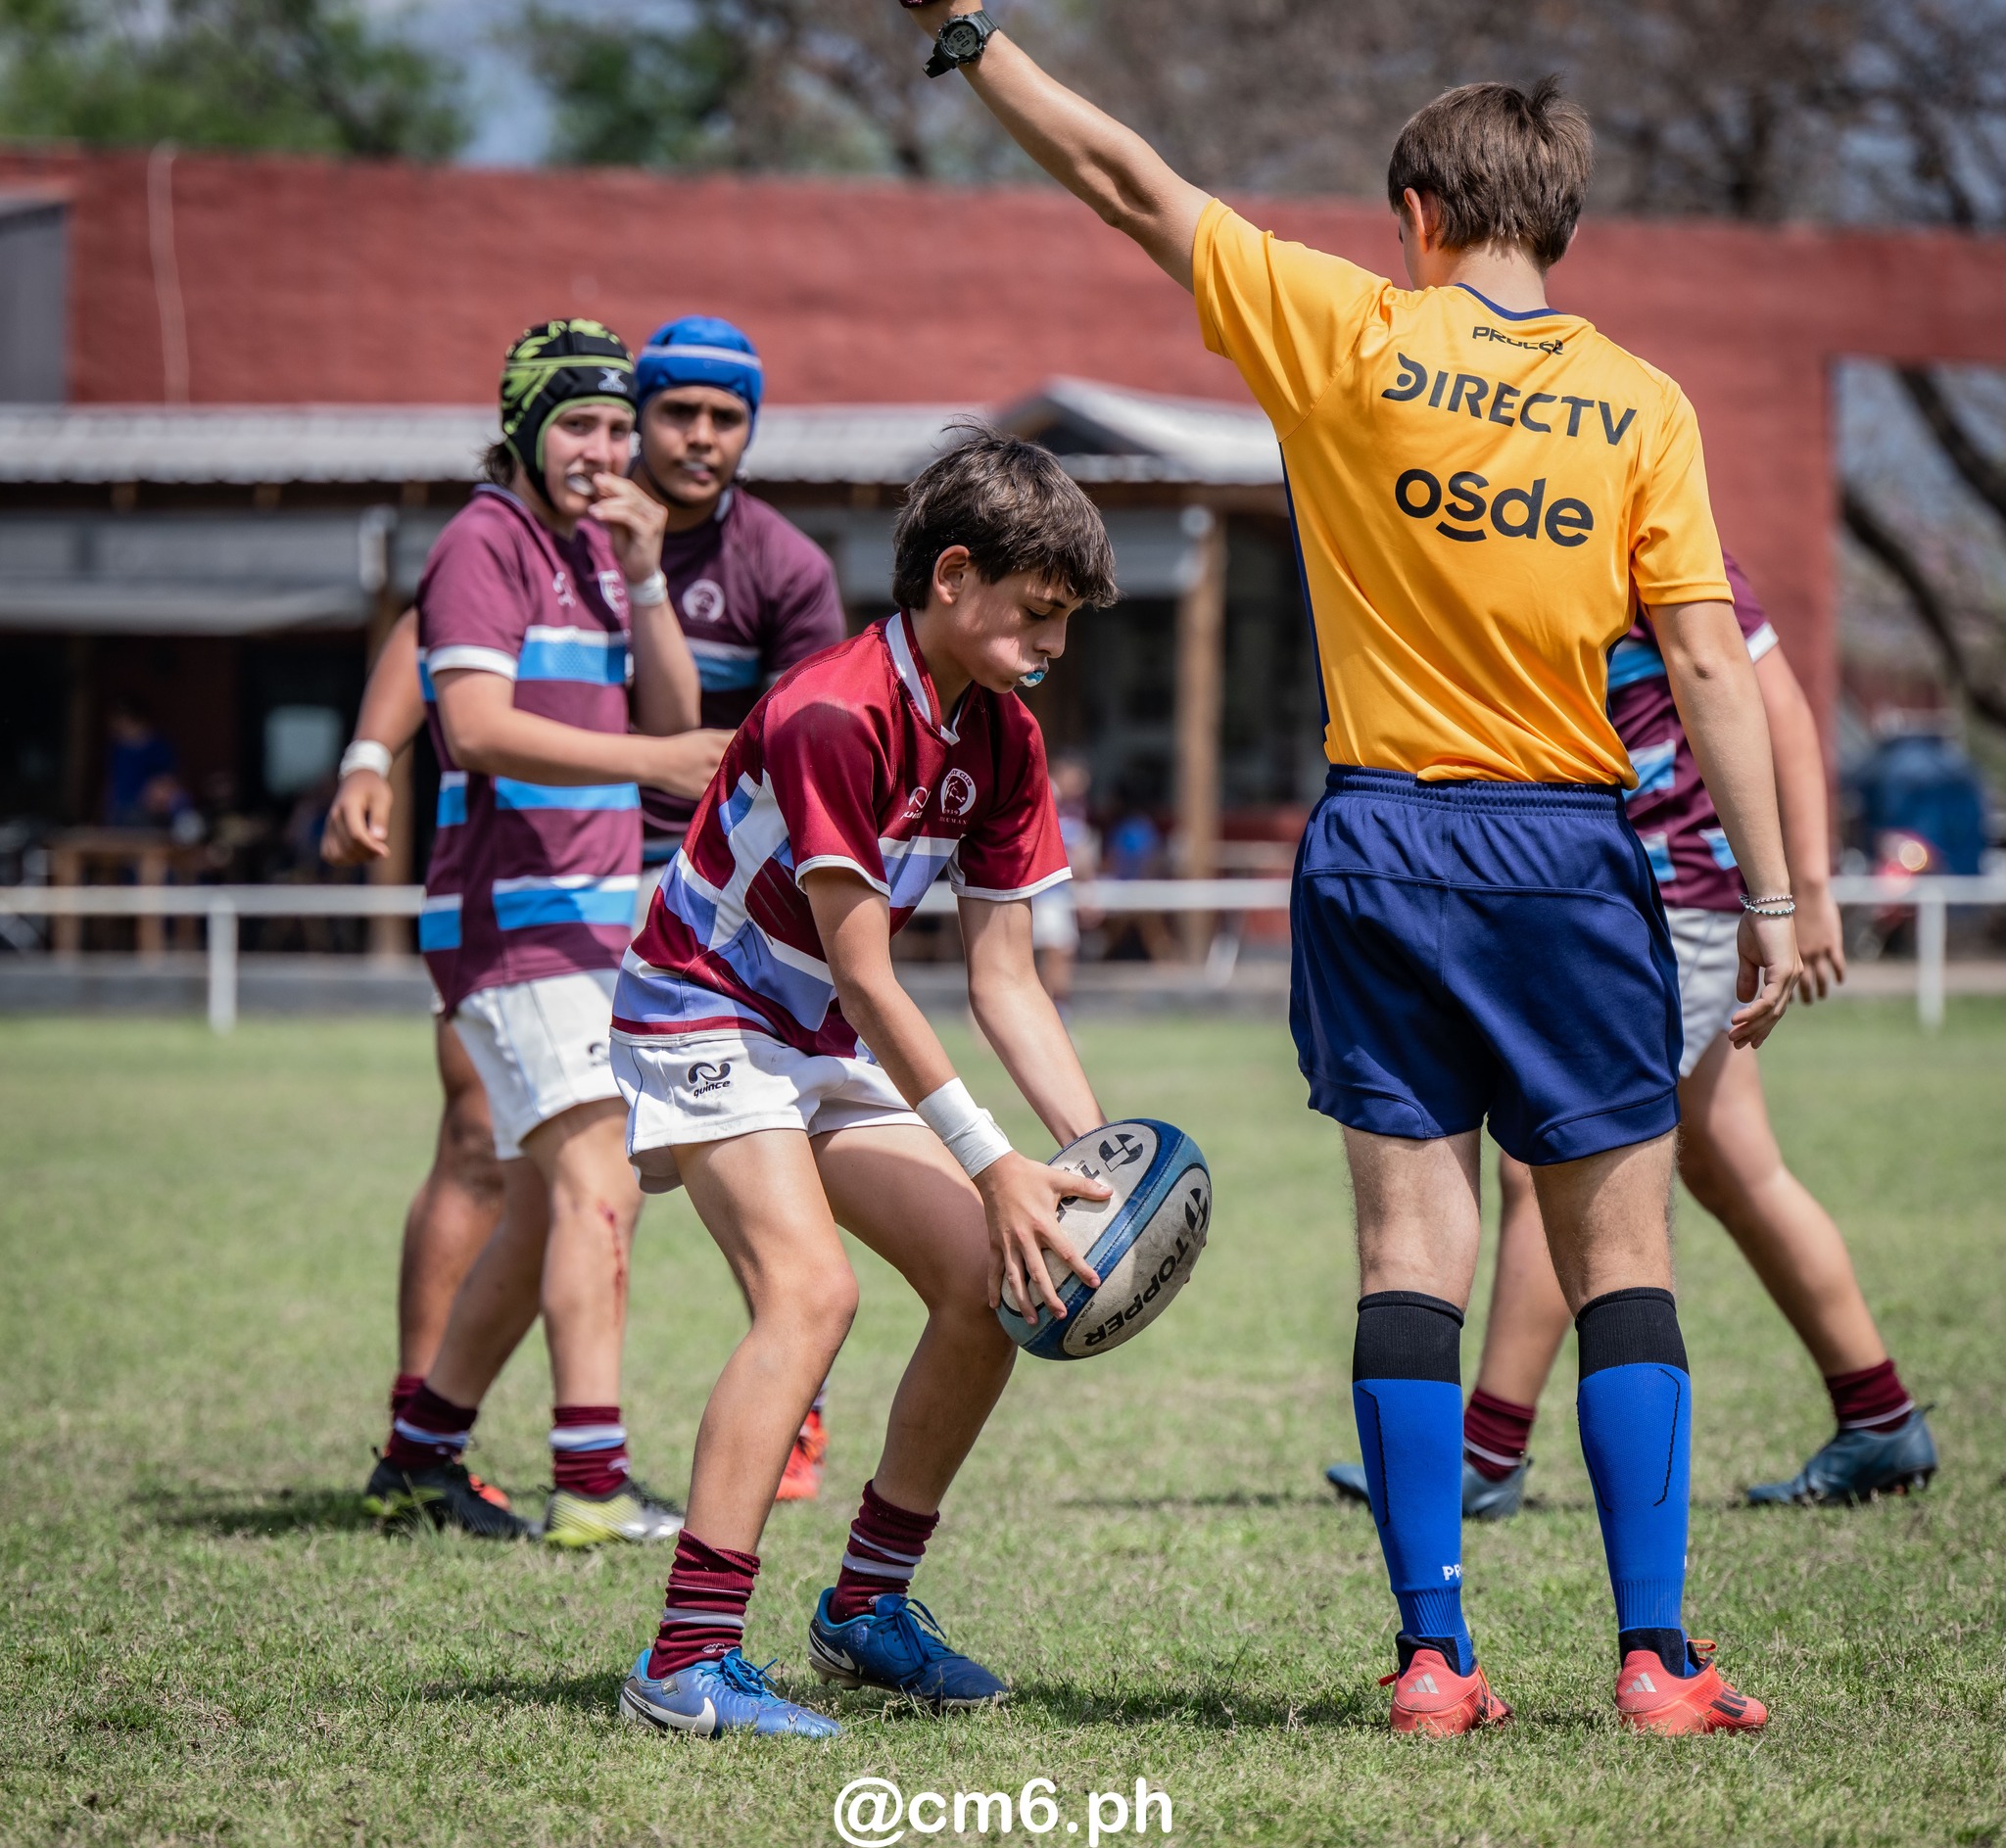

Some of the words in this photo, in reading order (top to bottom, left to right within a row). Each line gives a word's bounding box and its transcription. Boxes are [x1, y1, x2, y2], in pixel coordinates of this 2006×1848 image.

[1381, 352, 1638, 447] DIRECTV
[1395, 468, 1595, 547] osde
[693, 1080, 731, 1098] quince
[1083, 1236, 1189, 1348] TOPPER
